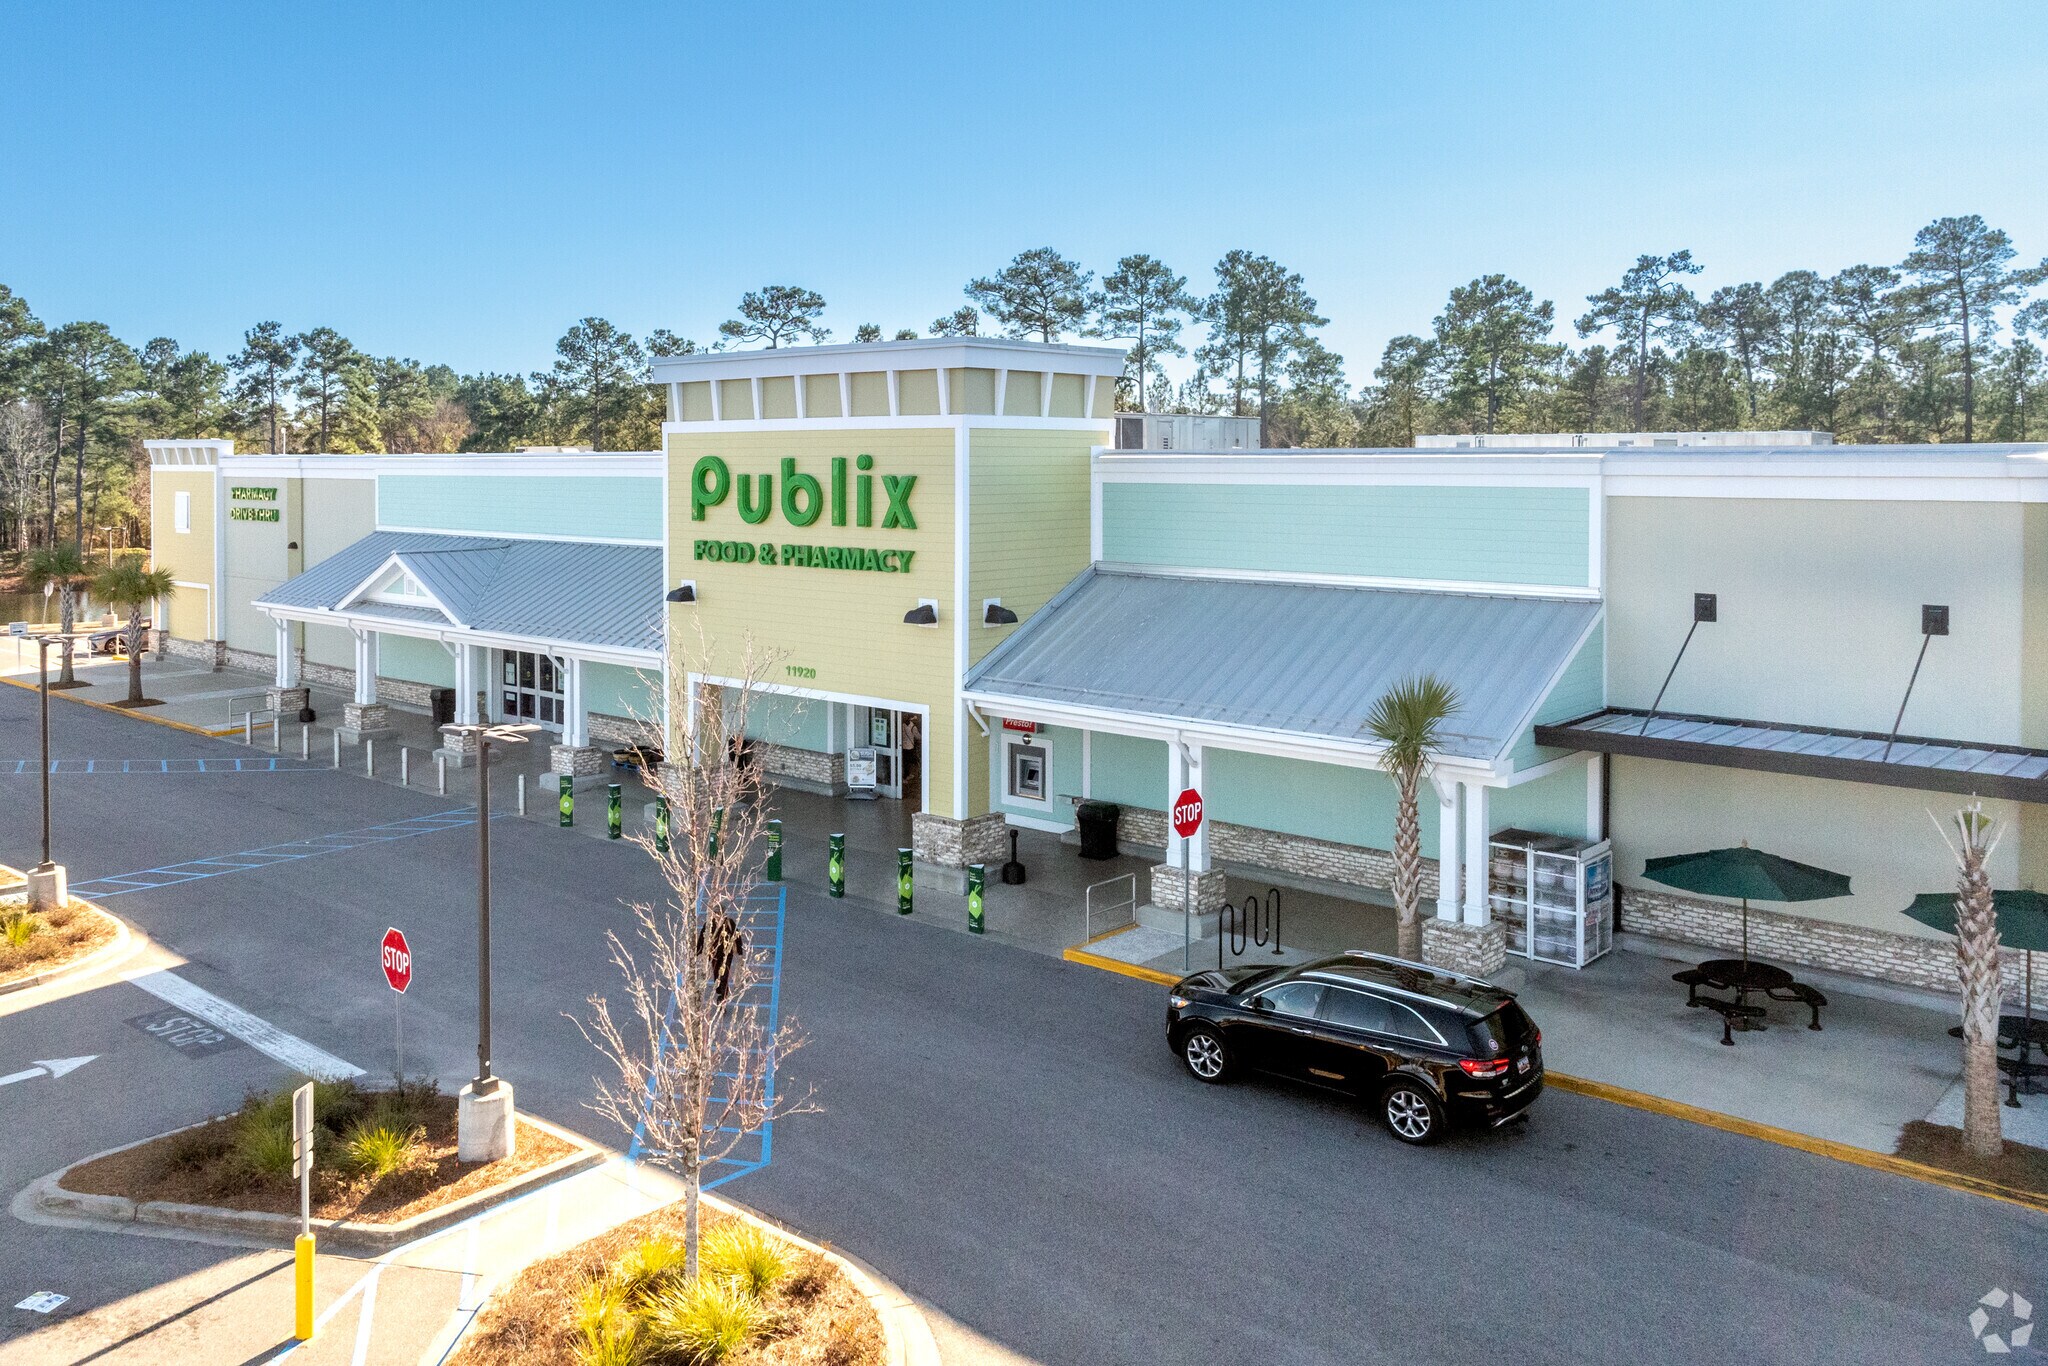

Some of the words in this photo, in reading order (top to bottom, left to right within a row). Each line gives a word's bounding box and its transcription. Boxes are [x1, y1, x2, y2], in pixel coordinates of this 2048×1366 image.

[231, 487, 277, 500] PHARMACY
[692, 454, 917, 529] Publix
[694, 540, 755, 563] FOOD
[758, 543, 777, 565] &
[781, 544, 915, 573] PHARMACY
[785, 665, 816, 679] 11920
[1005, 718, 1032, 728] Presto!
[1175, 802, 1201, 825] STOP
[384, 946, 409, 975] STOP
[145, 1017, 225, 1046] STOP
